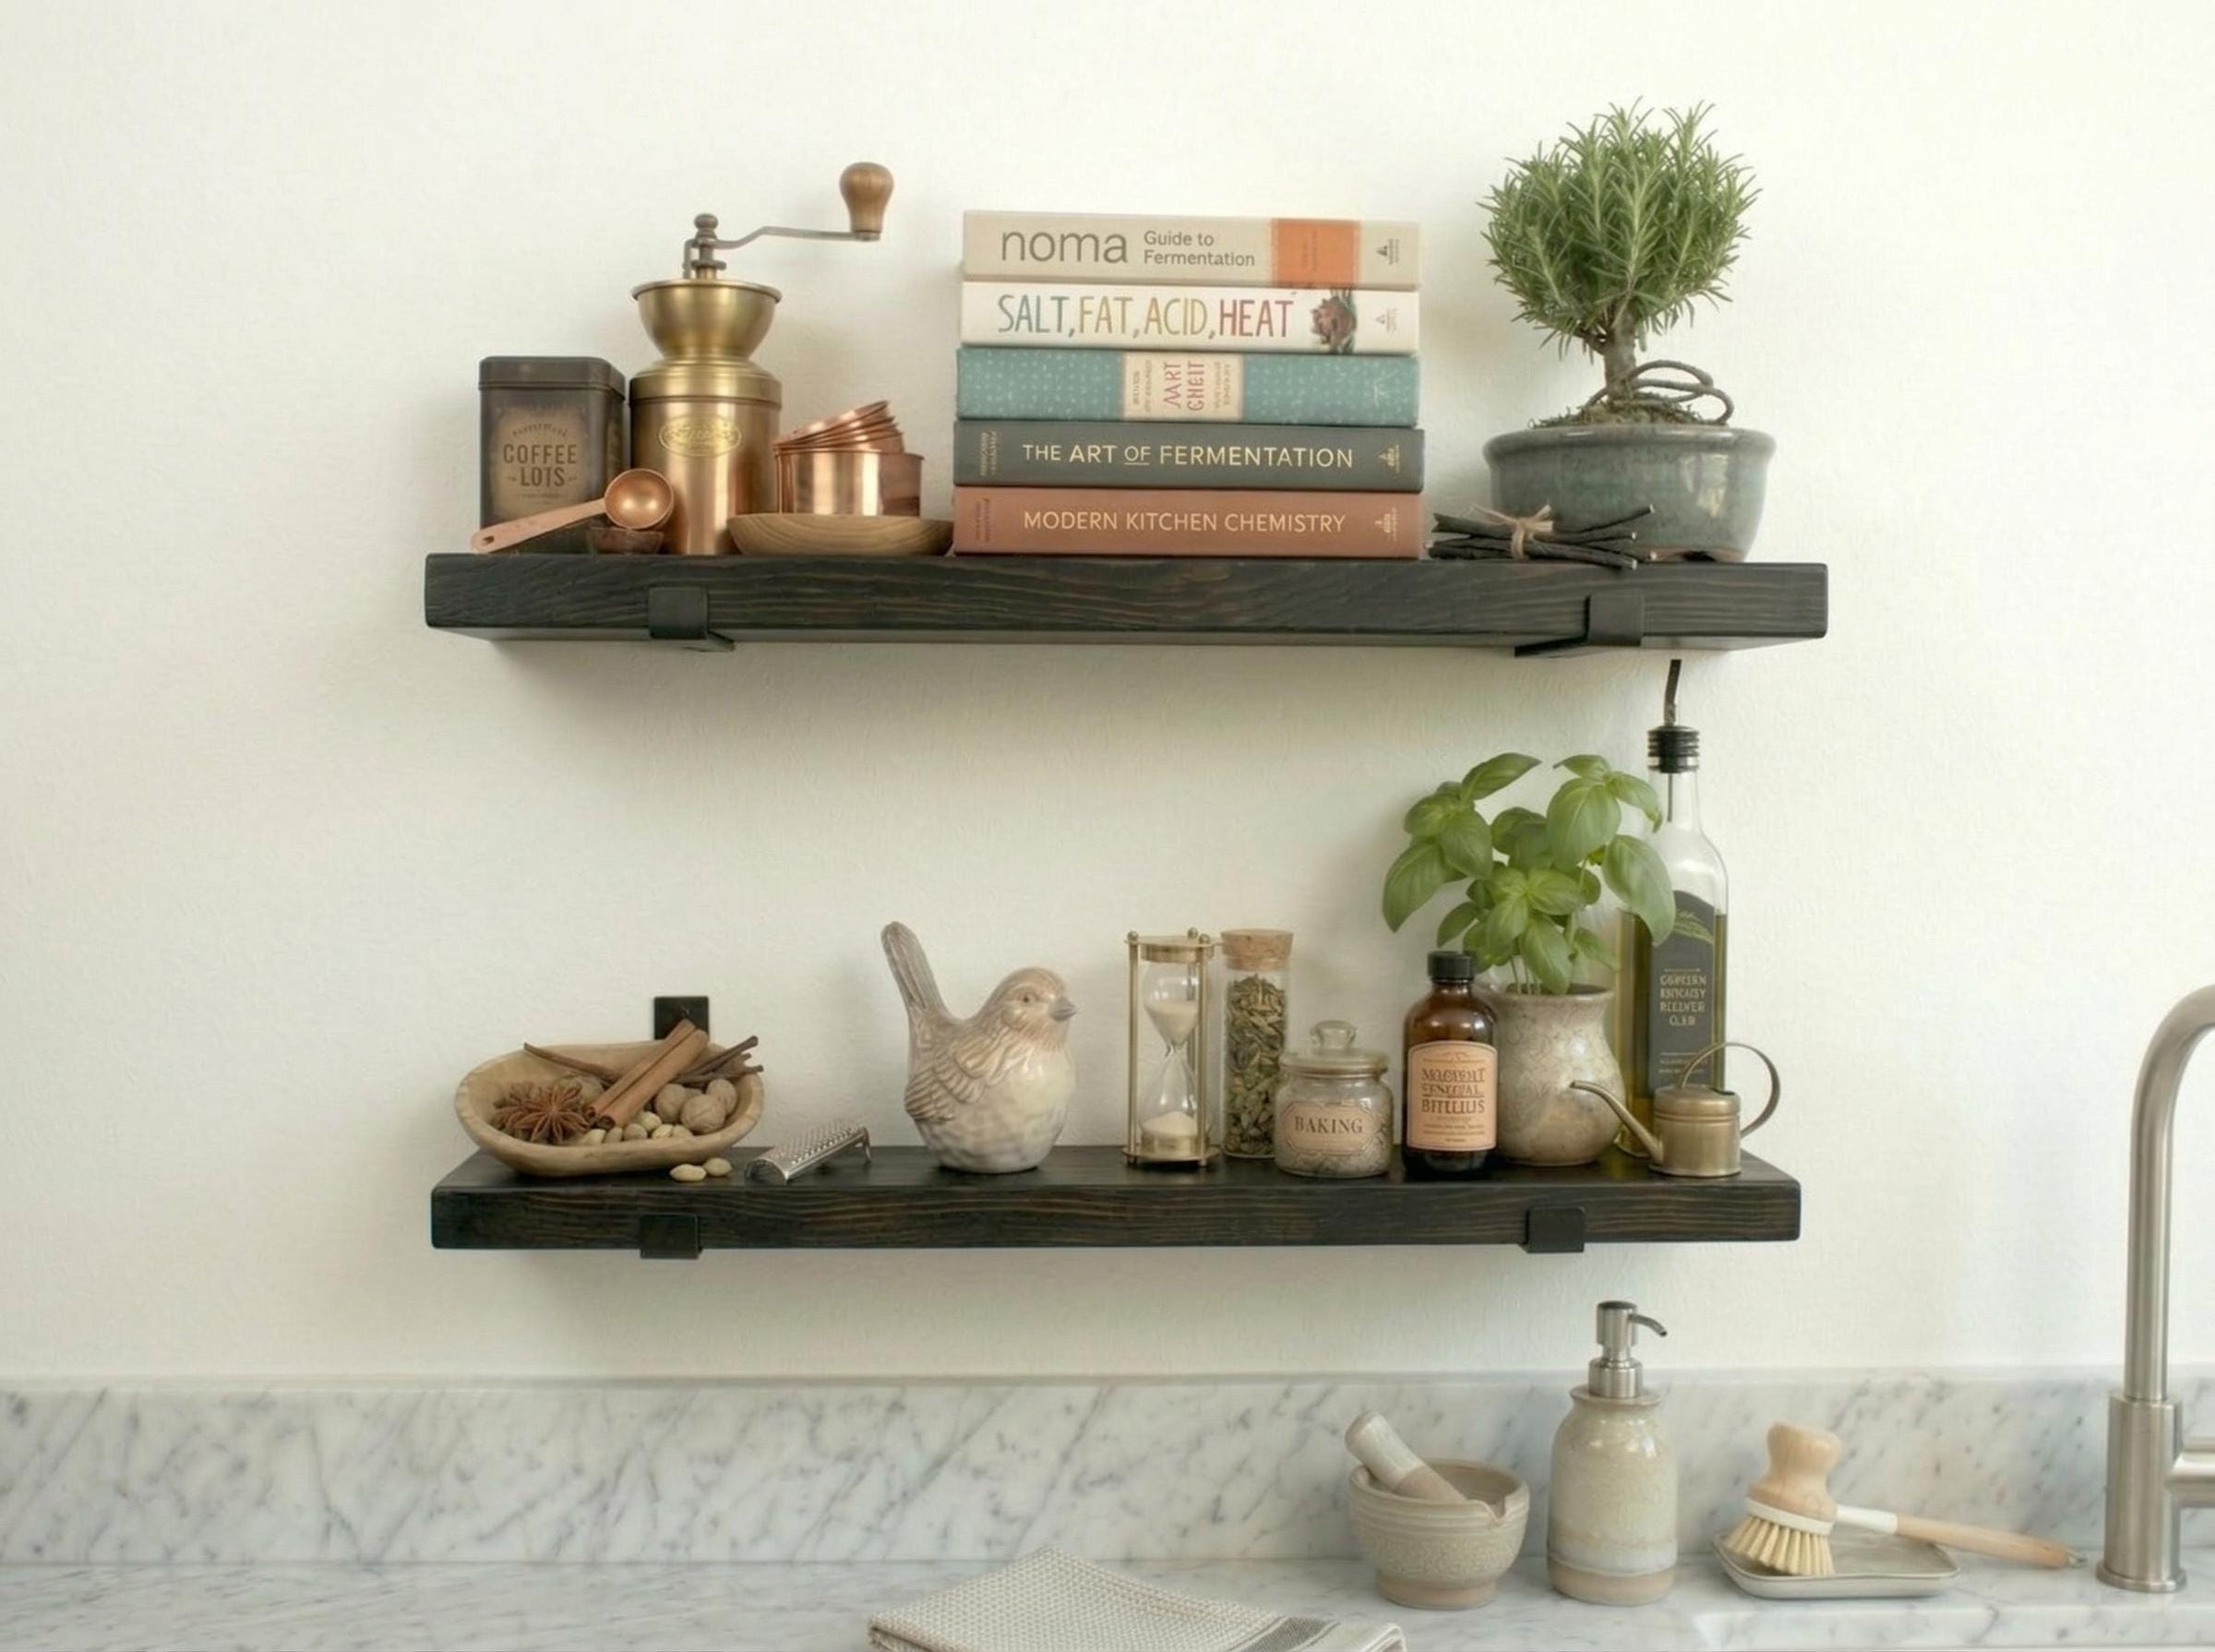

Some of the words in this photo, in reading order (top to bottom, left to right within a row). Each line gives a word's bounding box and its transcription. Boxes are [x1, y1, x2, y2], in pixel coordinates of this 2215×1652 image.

[1002, 232, 1128, 263] noma
[1143, 230, 1193, 246] Guide
[1198, 233, 1215, 246] to
[1143, 249, 1255, 266] Fermentation
[1219, 299, 1294, 338] HEAT
[503, 444, 577, 464] COFFEE
[1022, 444, 1061, 461] THE
[1069, 444, 1118, 463] ART
[1124, 445, 1151, 465] OF
[1159, 445, 1353, 468] FERMENTATION
[521, 467, 566, 487] LOTS
[1024, 511, 1118, 531] MODERN
[1126, 512, 1217, 531] KITCHEN
[1224, 513, 1347, 533] CHEMISTRY
[1294, 1116, 1363, 1134] BAKING
